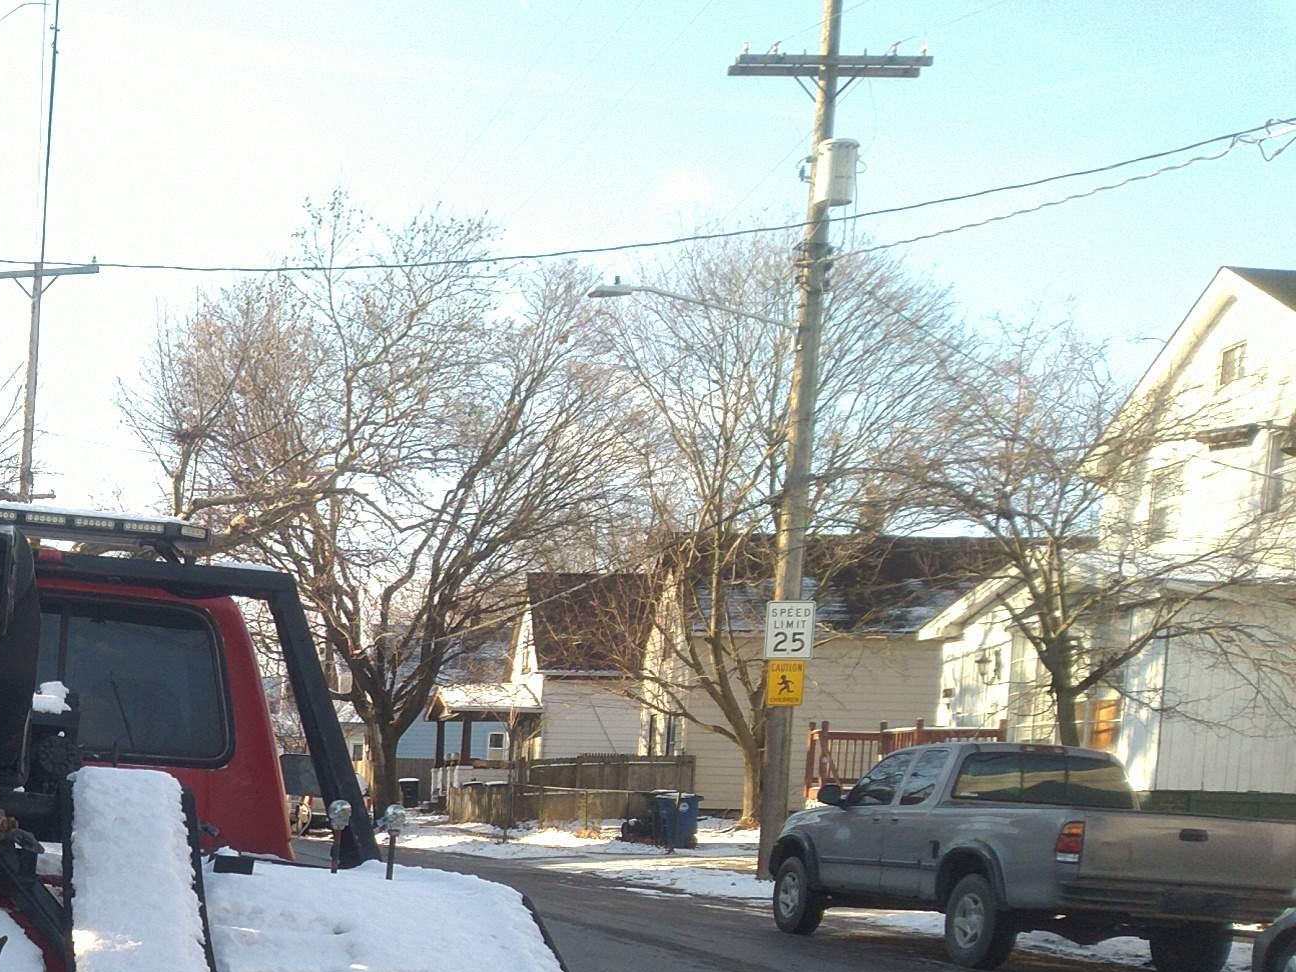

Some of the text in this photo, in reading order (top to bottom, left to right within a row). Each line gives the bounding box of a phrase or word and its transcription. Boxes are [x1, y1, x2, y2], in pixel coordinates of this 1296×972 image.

[772, 608, 811, 617] SPEED
[774, 620, 806, 629] LIMIT
[773, 632, 805, 652] 25
[771, 663, 803, 672] CAUTION
